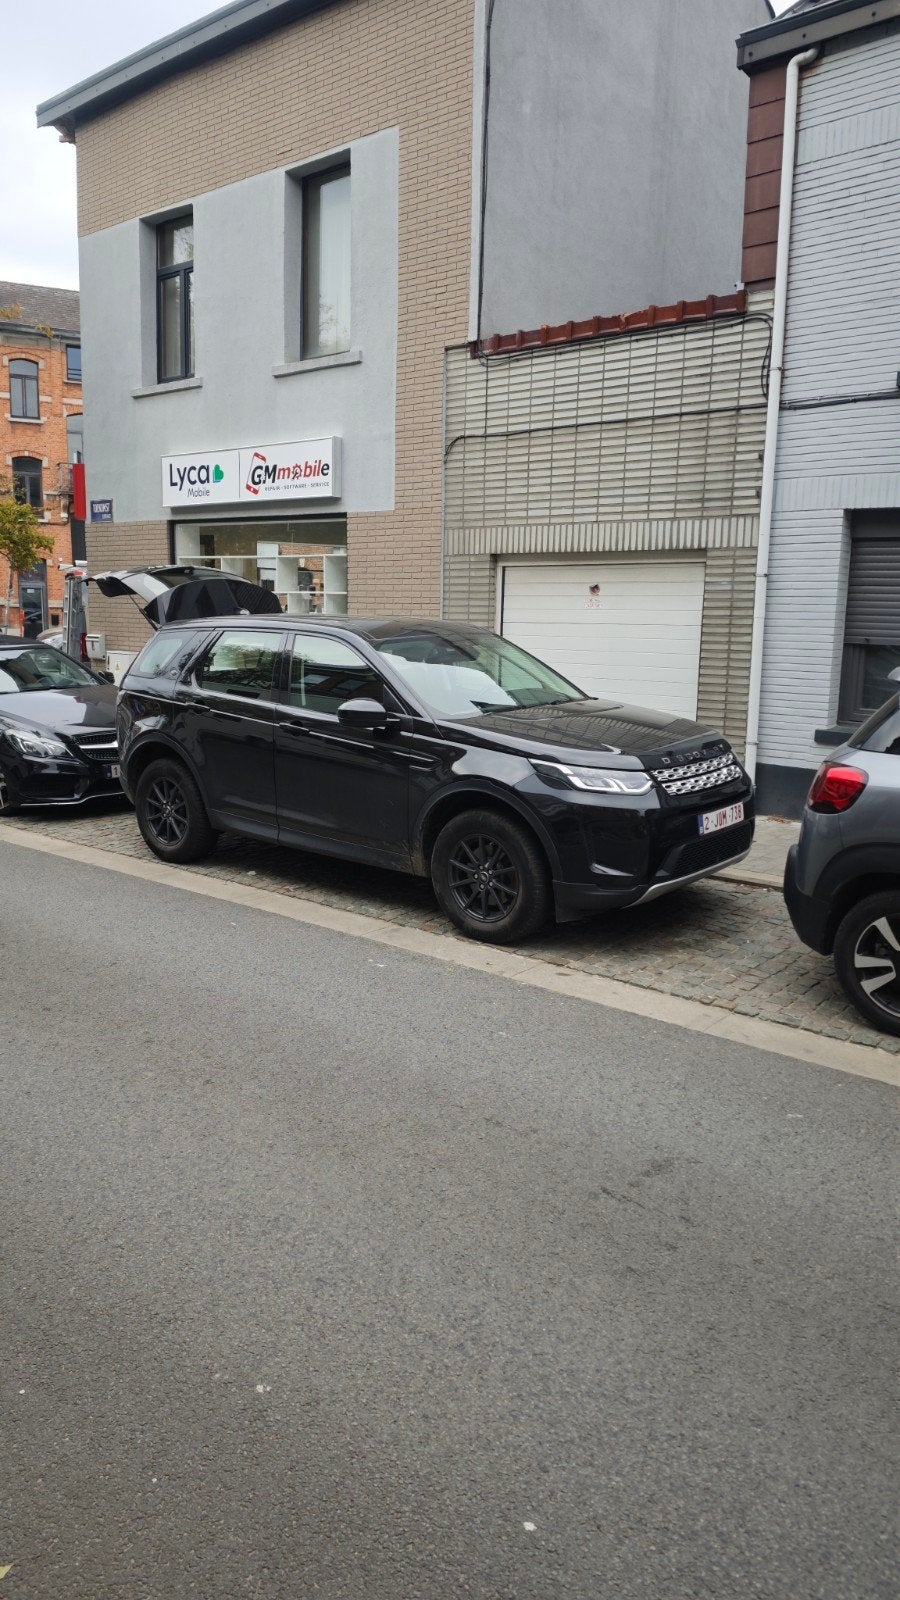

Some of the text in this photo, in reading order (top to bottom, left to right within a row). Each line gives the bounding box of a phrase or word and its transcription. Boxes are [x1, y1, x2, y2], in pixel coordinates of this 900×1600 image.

[169, 463, 210, 491] Lyca
[283, 483, 307, 491] SOFTWARE
[187, 488, 210, 498] Mobile
